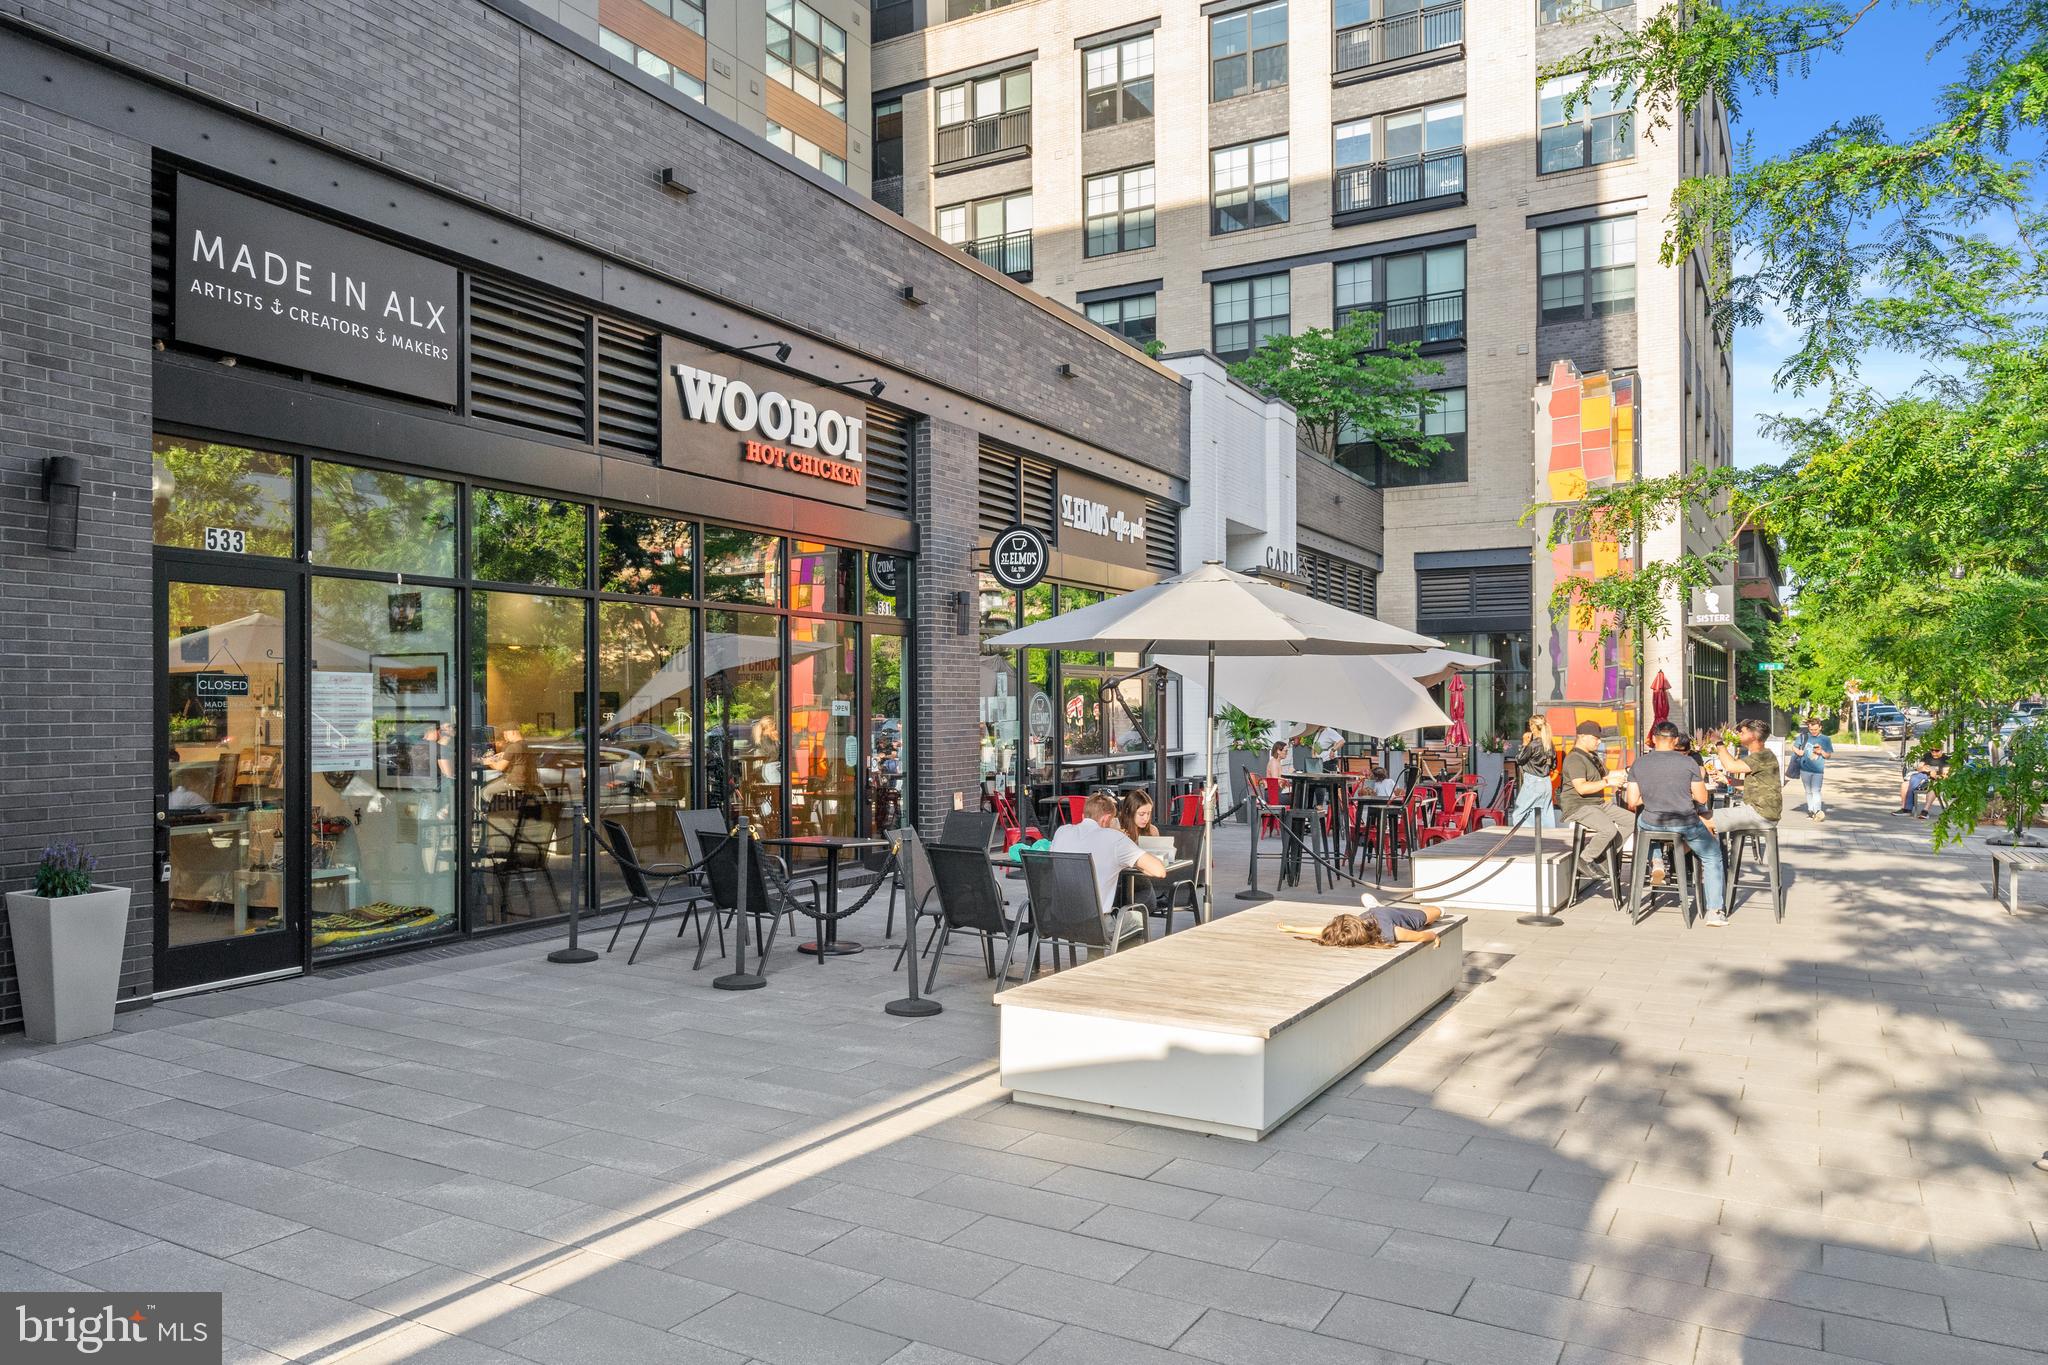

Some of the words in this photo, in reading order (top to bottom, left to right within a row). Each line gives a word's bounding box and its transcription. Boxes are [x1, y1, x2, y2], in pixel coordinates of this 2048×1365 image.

[192, 229, 312, 296] MADE
[331, 271, 366, 311] IN
[383, 291, 446, 334] ALX
[190, 279, 263, 311] ARTISTS
[289, 306, 369, 340] CREATORS
[391, 334, 449, 361] MAKERS
[677, 363, 863, 462] WOOBOI
[746, 440, 786, 468] HOT
[787, 451, 862, 487] CHICKEN
[207, 528, 244, 552] 533
[1009, 552, 1037, 565] ELMO'S
[1266, 546, 1309, 578] GABLES
[878, 601, 891, 615] 531
[198, 680, 248, 691] CLOSED
[834, 704, 849, 712] OPEN
